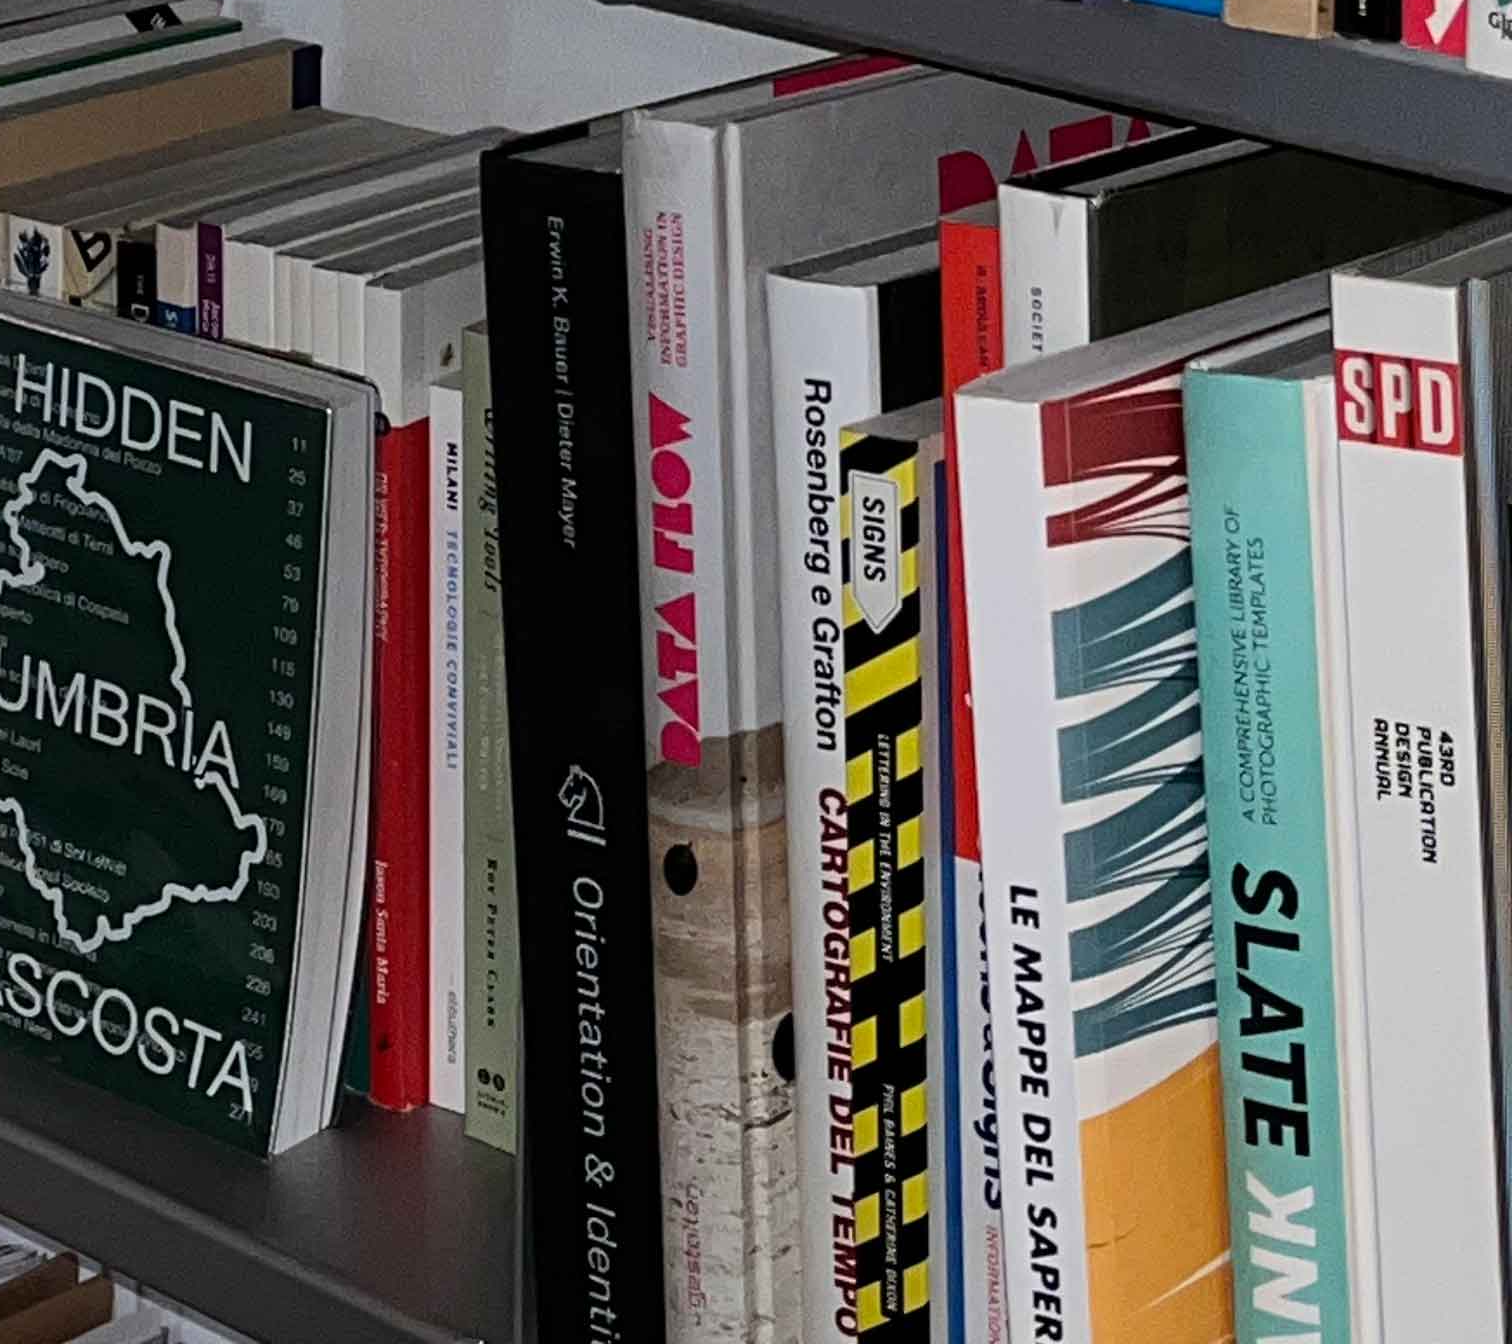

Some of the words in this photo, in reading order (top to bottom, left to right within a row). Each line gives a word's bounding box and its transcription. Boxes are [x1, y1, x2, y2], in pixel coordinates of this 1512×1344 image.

[546, 215, 568, 281] Erwin
[549, 287, 569, 309] K.
[550, 316, 574, 383] Bauer
[13, 351, 254, 483] HIDDEN
[555, 403, 578, 468] Dieter
[1341, 357, 1458, 451] SPD
[445, 442, 459, 512] MILANI
[554, 475, 581, 548] Mayer
[803, 379, 837, 576] Rosenberg
[860, 497, 890, 583] SIGNS
[1223, 504, 1240, 534] OF
[445, 529, 459, 653] TECNOLOGIE
[809, 585, 833, 605] e
[1226, 540, 1246, 623] LIBRARY
[1246, 536, 1269, 653] TEMPLATES
[445, 659, 460, 771] CONVIVIALI
[811, 617, 844, 751] Grafton
[1232, 629, 1255, 803] COMPREHENSIVE
[877, 732, 892, 809] LETTERING
[1255, 659, 1279, 826] PHOTOGRAPHIC
[1372, 717, 1394, 801] ANNUAL
[1393, 720, 1414, 800] DESIGN
[1436, 729, 1456, 788] 43RD
[879, 812, 892, 830] IN
[1240, 808, 1255, 823] A
[1414, 725, 1439, 865] PUBLICATION
[879, 832, 893, 859] THE
[817, 787, 855, 1084] CARTOGRAFIE
[878, 861, 894, 963] ENVIRONMENT
[1230, 863, 1311, 1158] SLATE
[830, 1094, 859, 1176] DEL
[830, 1193, 861, 1336] TEMPO
